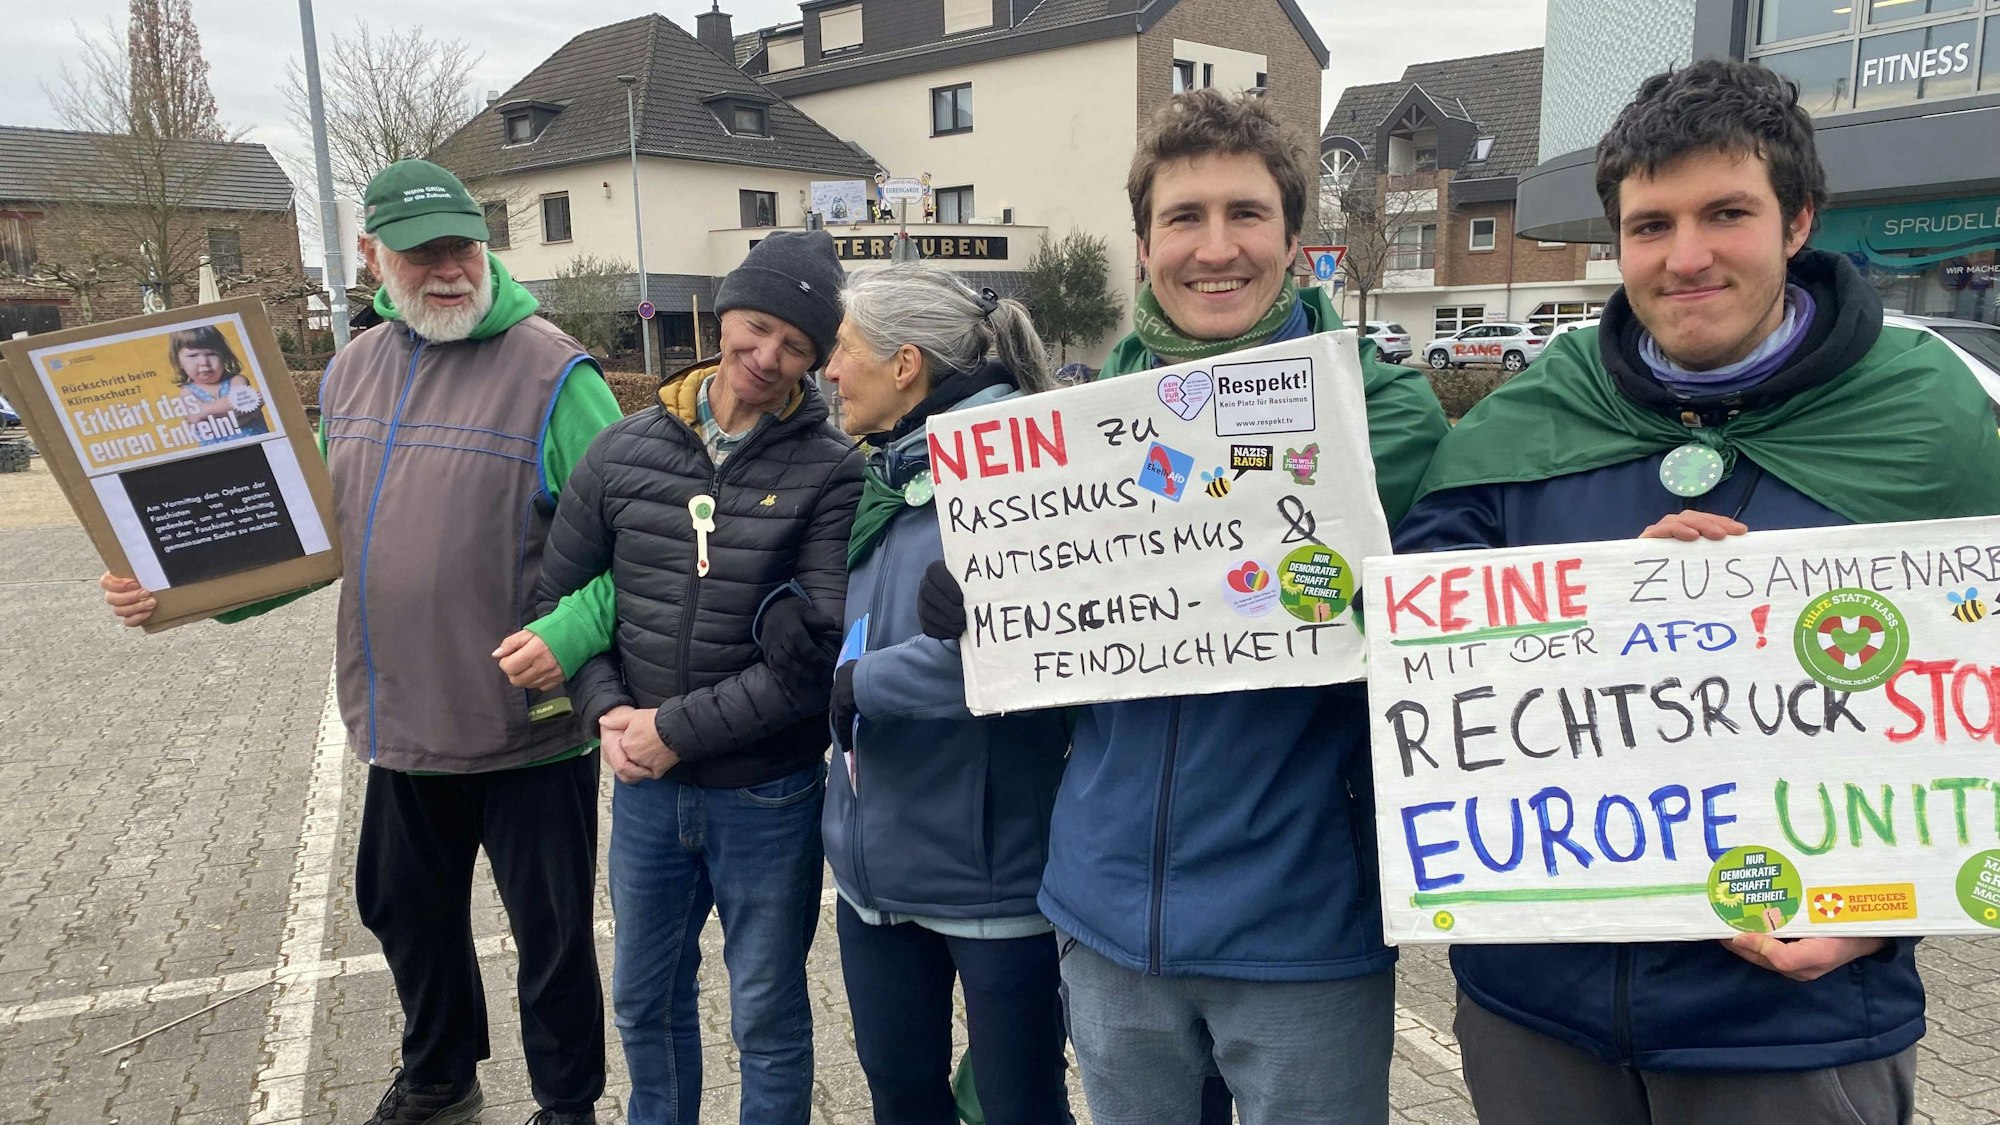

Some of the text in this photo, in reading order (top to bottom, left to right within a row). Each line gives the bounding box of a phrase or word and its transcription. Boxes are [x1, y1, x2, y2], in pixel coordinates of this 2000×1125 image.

[1862, 42, 1970, 87] FITNESS
[403, 188, 425, 196] Wähle
[1946, 266, 1964, 274] WIR
[61, 370, 157, 395] Rückschritt beim
[1218, 371, 1307, 395] Respekt!
[67, 386, 142, 407] Klimaschutz?
[1219, 396, 1308, 408] Kein Platz für Rassismus
[73, 399, 155, 436] Erklärt
[155, 394, 200, 420] das
[1236, 418, 1293, 428] www.respekt.tv
[89, 410, 242, 463] euren Enkeln!
[929, 410, 1068, 485] NEIN
[1233, 457, 1267, 467] RAUS!
[1234, 447, 1268, 457] NAZIS
[146, 481, 266, 513] Am Vormittag den Opfern der
[149, 509, 191, 523] Faschisten
[241, 491, 270, 503] gestern
[948, 477, 1157, 533] RASSISMUS,
[155, 501, 275, 533] gedenken, um am Nachmittag
[159, 534, 173, 542] mit
[175, 530, 192, 538] den
[194, 520, 235, 534] Faschisten
[256, 510, 278, 520] heute
[163, 536, 212, 553] gemeinsame
[212, 530, 237, 540] Sache
[249, 521, 281, 532] machen.
[964, 495, 1327, 582] ANTISEMITISMUS &
[1289, 562, 1339, 577] DEMOKRATIE.
[1313, 553, 1330, 563] NUR
[1295, 574, 1329, 586] SCHAFFT
[1304, 586, 1338, 599] FREIHEIT.
[1384, 558, 1589, 634] KEINE
[974, 587, 1202, 647] MENSCHEN-
[1803, 593, 1899, 630] HILFE STATT HASS.
[1034, 623, 1347, 682] FEINDLICHKEIT
[1403, 642, 1487, 684] MIT
[1510, 627, 1599, 663] DER
[1621, 620, 1738, 656] AFD
[1826, 673, 1880, 685] GRUENE.DE/ASYL
[1386, 676, 1867, 777] RECHTSRUCK
[1401, 782, 1738, 891] EUROPE
[1746, 854, 1765, 865] NUR
[1720, 867, 1779, 881] DEMOKRATIE.
[1731, 879, 1770, 891] SCHAFFT
[1746, 890, 1785, 902] FREIHEIT.
[1849, 893, 1906, 903] REFUGEES
[1849, 902, 1909, 912] WELCOME
[1973, 886, 2000, 904] MAC
